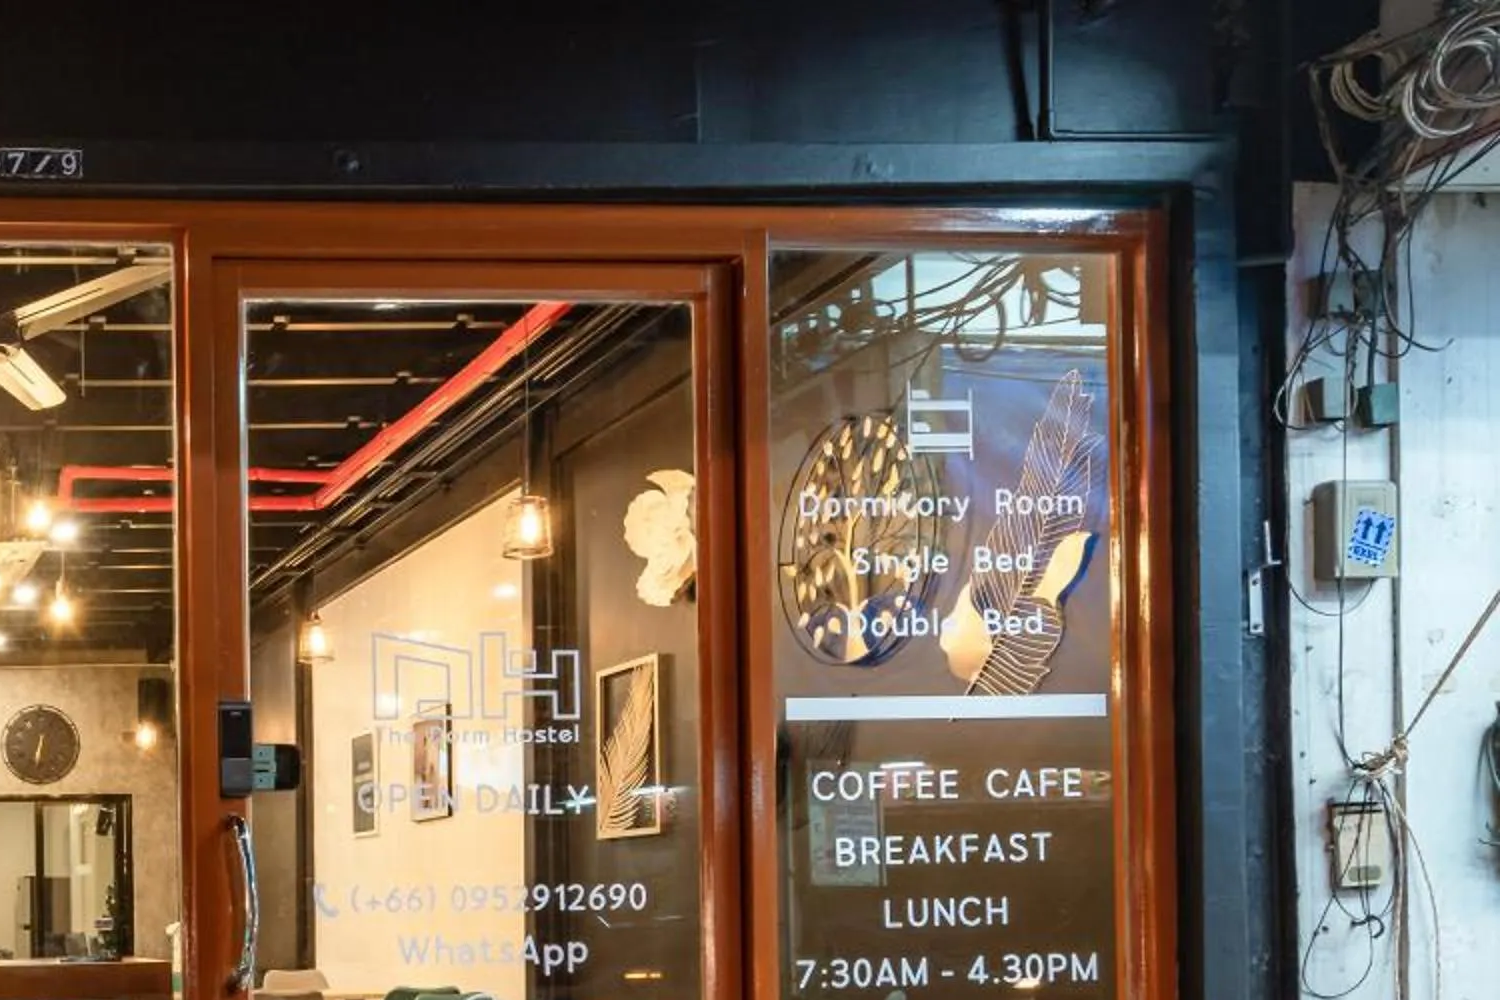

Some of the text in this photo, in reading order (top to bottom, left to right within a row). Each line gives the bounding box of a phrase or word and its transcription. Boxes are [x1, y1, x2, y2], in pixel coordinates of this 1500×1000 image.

[798, 489, 1083, 522] Dormitory Room
[850, 545, 1034, 581] Single Bed
[982, 608, 1043, 637] Bed
[503, 724, 580, 745] Hostel
[356, 782, 590, 816] OPEN DAILY
[811, 767, 1083, 801] COFFEE CAFE
[835, 832, 1053, 867] BREAKFAST
[350, 883, 647, 914] (+66) 0952912690
[883, 896, 1010, 929] LUNCH
[398, 935, 590, 977] WhatsApp
[796, 956, 929, 989] 7:30AM
[967, 951, 1099, 985] 4.30PM
